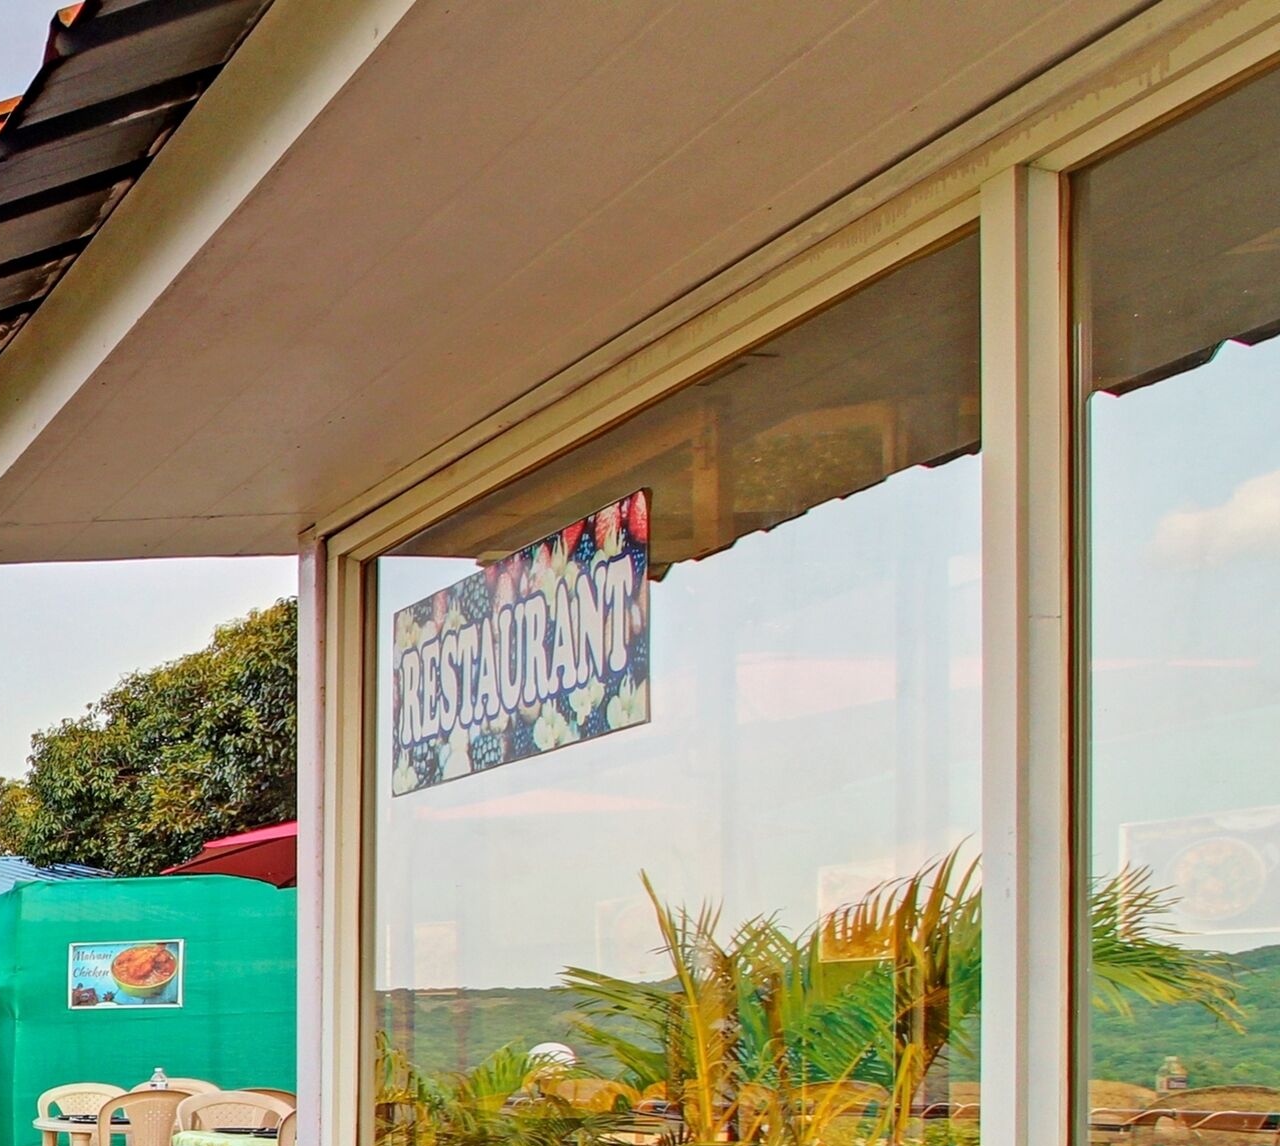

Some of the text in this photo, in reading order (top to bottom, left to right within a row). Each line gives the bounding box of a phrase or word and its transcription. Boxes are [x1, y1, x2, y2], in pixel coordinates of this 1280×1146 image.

[400, 552, 634, 749] RESTAURANT
[73, 950, 113, 961] Malvani
[73, 966, 109, 978] Chicken
